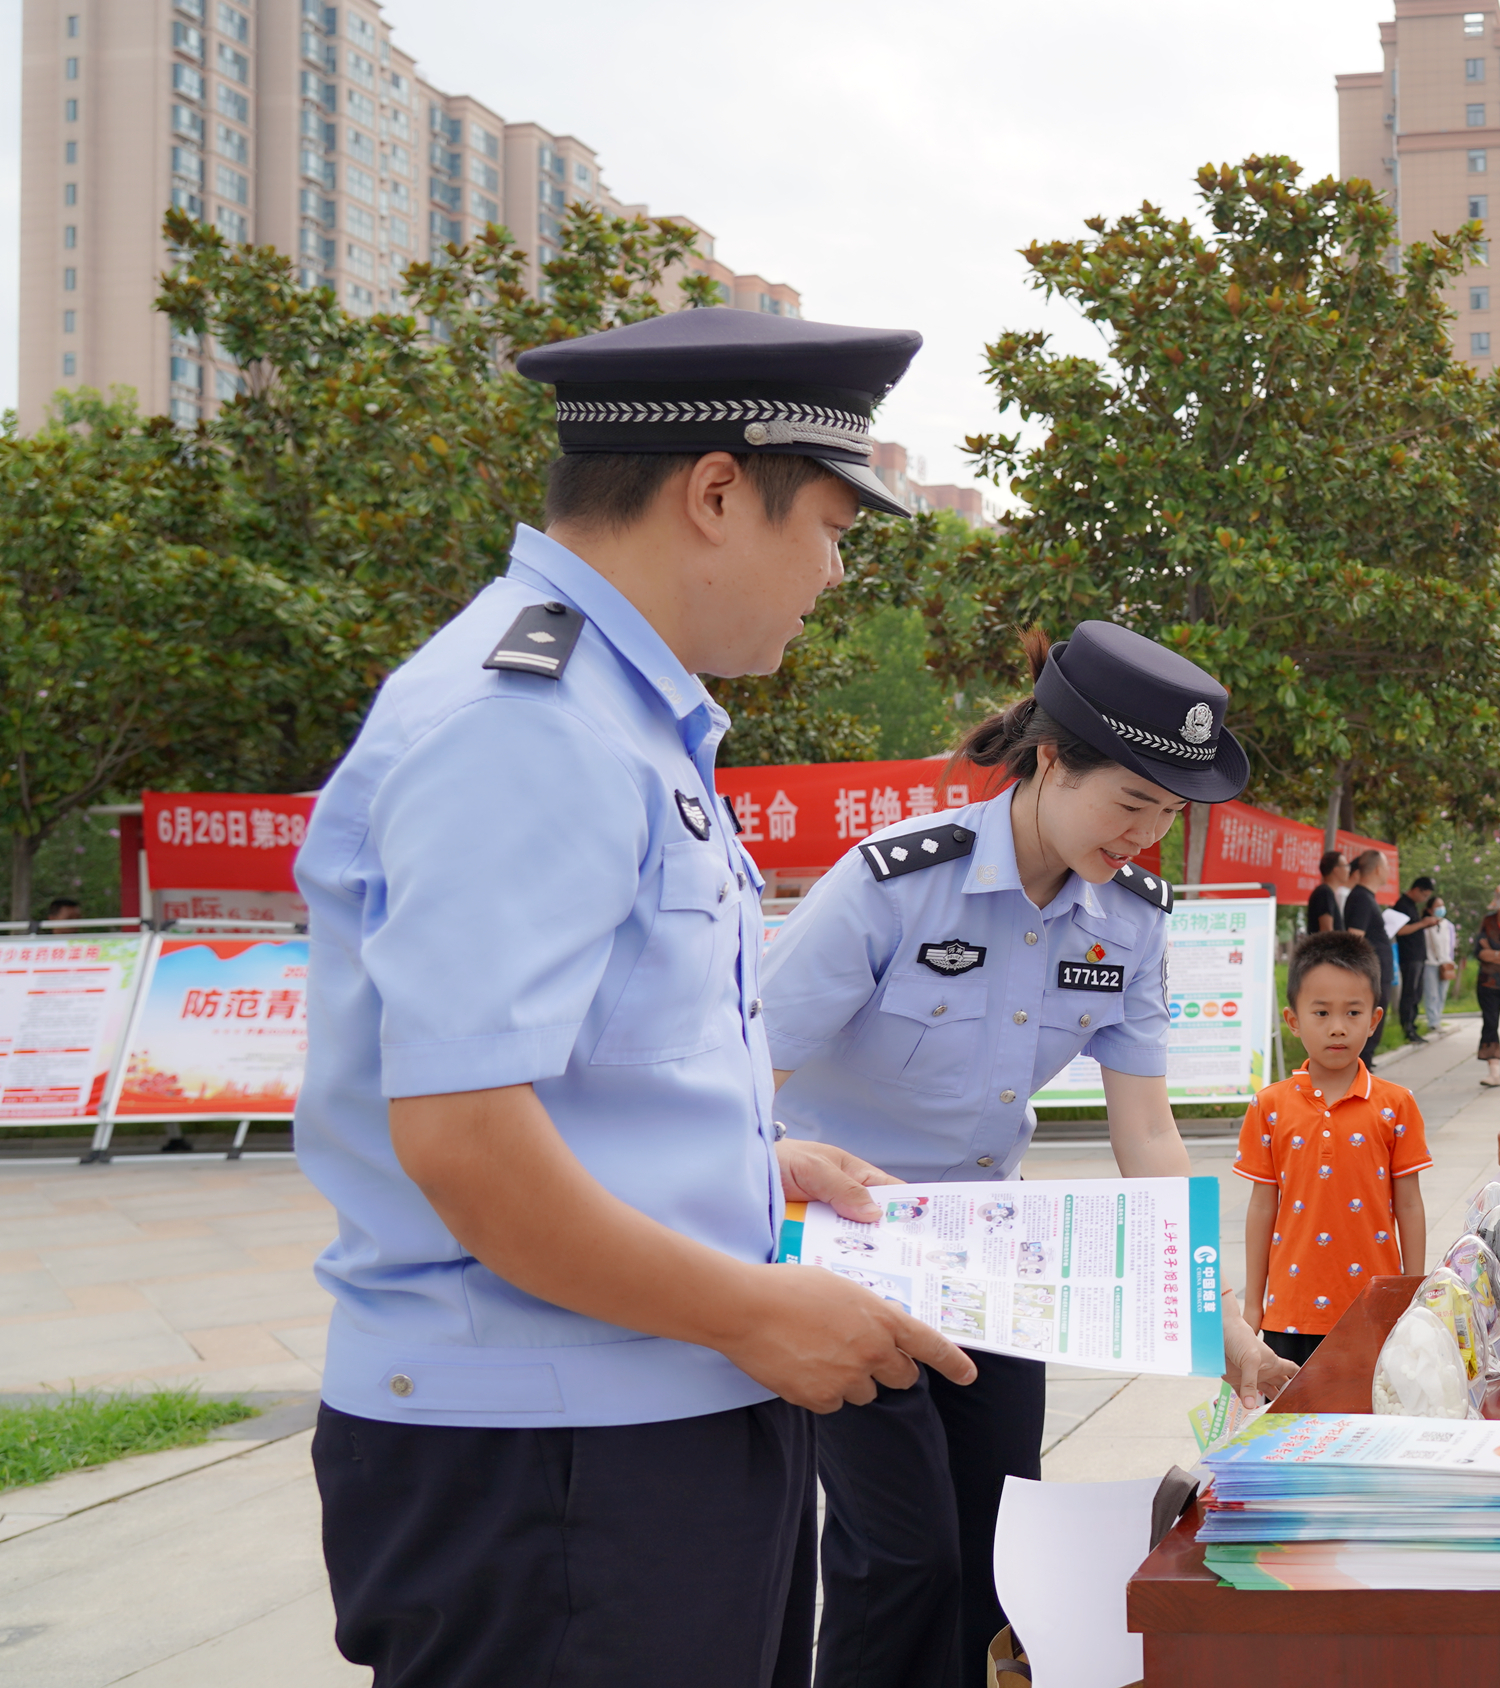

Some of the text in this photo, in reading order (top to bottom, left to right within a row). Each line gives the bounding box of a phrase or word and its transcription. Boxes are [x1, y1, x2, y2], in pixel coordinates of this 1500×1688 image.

[731, 790, 799, 842] 生命
[1165, 912, 1246, 931] 药物滥用
[0, 945, 101, 963] 少年药物滥用
[1063, 967, 1120, 987] 177122
[180, 989, 307, 1020] 防范青
[1202, 1266, 1216, 1313] 中国烟草
